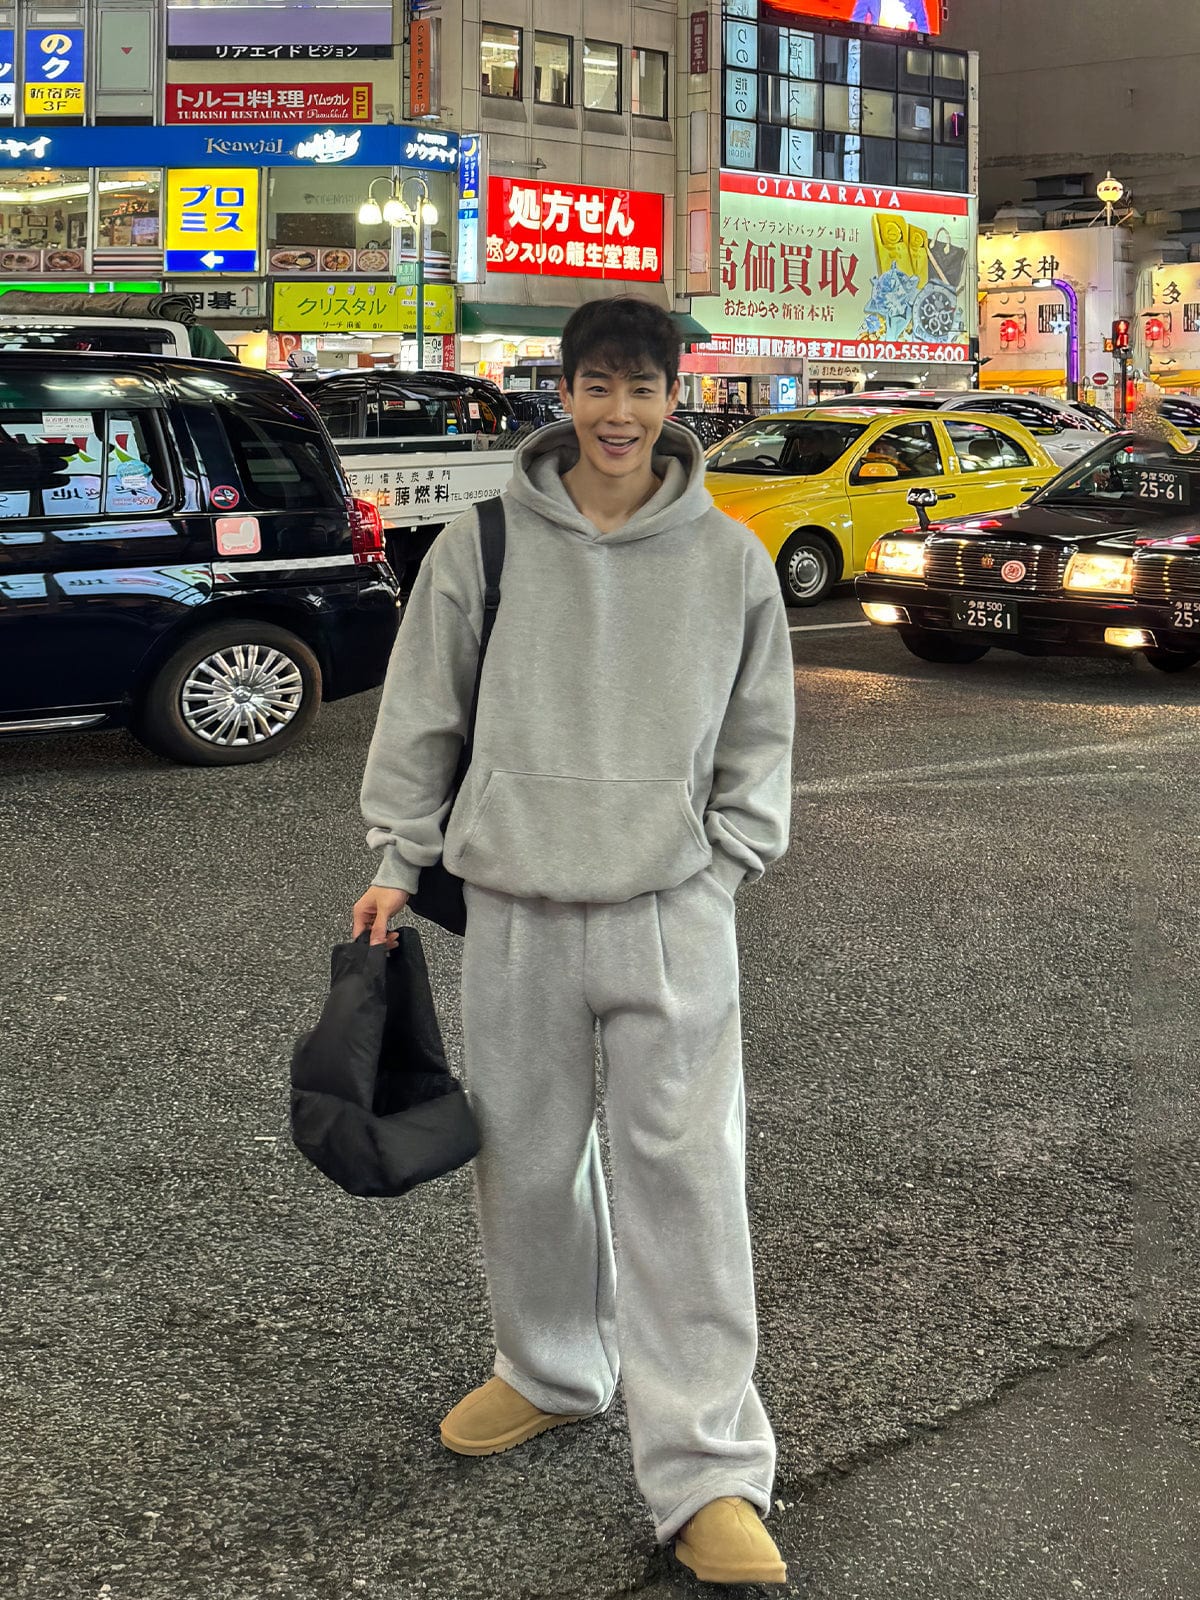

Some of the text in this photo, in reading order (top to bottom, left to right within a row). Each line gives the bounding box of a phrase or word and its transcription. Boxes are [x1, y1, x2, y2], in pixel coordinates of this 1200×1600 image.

[216, 45, 358, 59] リアエイド ビジョン
[30, 88, 81, 99] 新宿院
[176, 89, 305, 108] トルコ料理
[43, 101, 67, 111] 3F
[178, 110, 227, 120] TURKISH
[231, 110, 304, 119] RESTAURANT
[757, 177, 901, 208] OTAKARAYA
[508, 186, 635, 237] 処方せん
[720, 236, 860, 298] 高価買取
[977, 255, 1060, 283] 多天神
[297, 297, 388, 317] クリスタル
[724, 298, 835, 322] おたからや 新宿本店
[857, 343, 965, 362] 0120-555-600
[1158, 472, 1175, 483] 500
[377, 484, 449, 508] 佐藤燃料
[1139, 481, 1182, 501] 25-61
[986, 601, 1003, 611] 500
[967, 609, 1011, 630] 25-61
